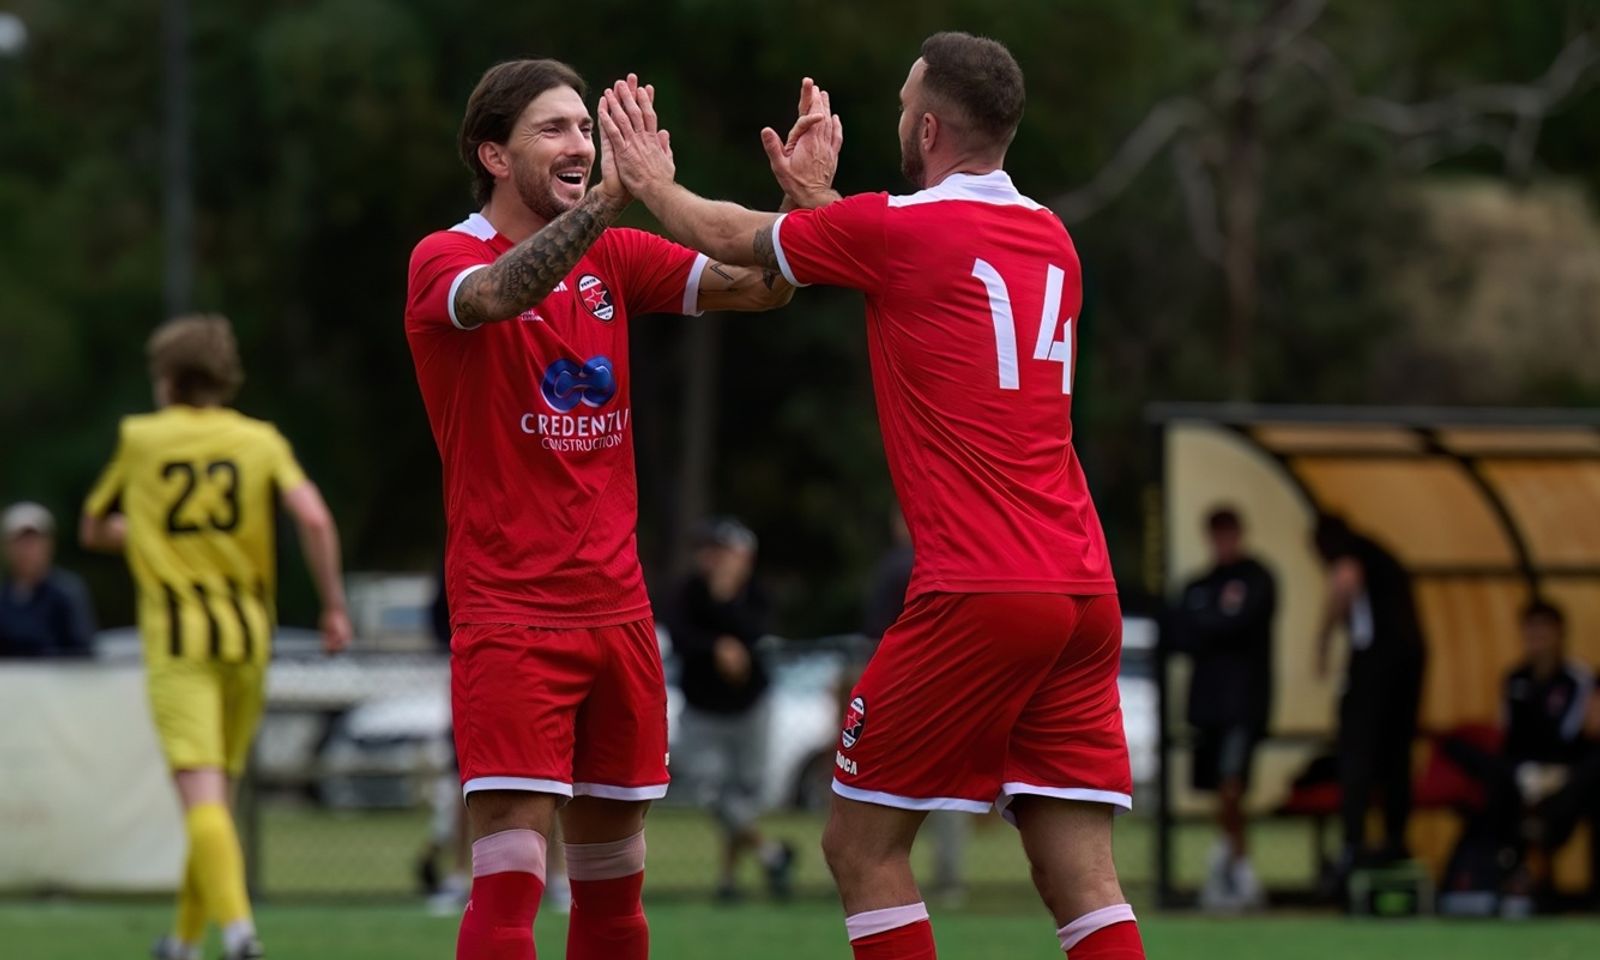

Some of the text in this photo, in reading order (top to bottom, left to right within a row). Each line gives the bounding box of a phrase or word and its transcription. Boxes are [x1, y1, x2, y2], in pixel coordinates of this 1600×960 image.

[971, 257, 1072, 395] 14
[541, 433, 622, 452] CONSTRUCTION
[161, 460, 240, 533] 23
